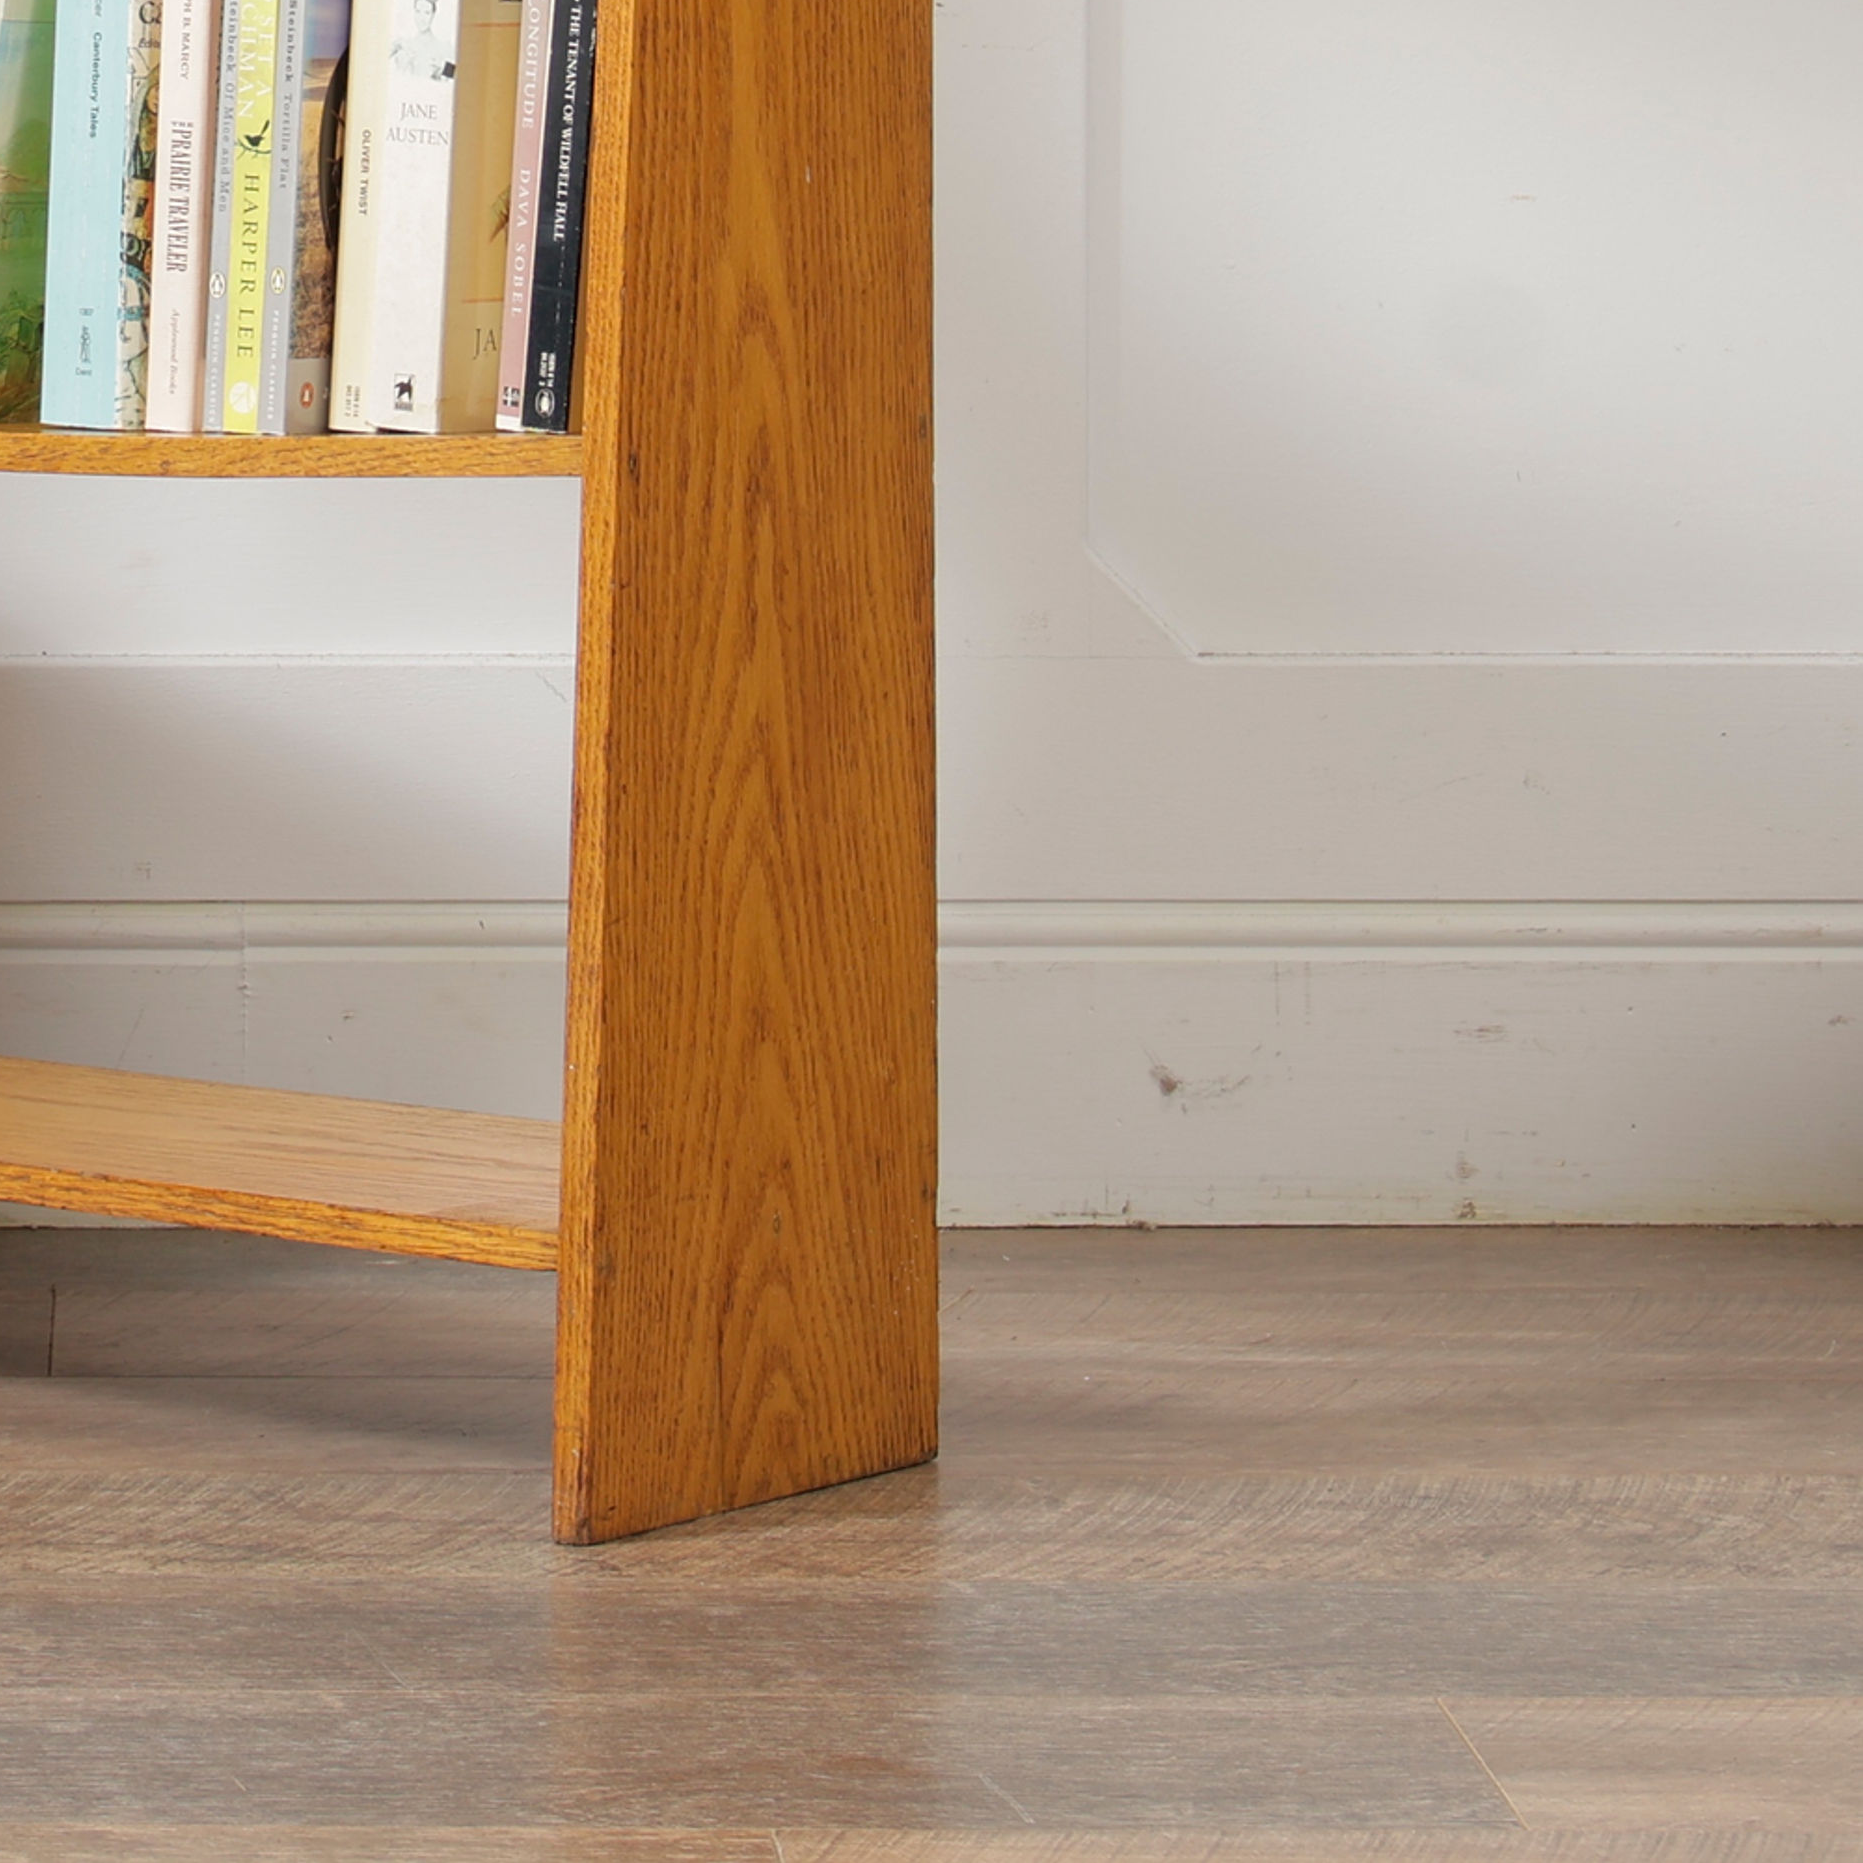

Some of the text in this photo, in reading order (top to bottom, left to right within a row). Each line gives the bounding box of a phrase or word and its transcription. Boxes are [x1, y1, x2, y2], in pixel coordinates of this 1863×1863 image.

[178, 32, 191, 80] MARCY
[283, 0, 298, 82] Steinbeck
[87, 31, 103, 138] Canterbury Tales
[400, 103, 437, 121] JANE
[552, 5, 581, 242] THE TENANT OF WILDFELL HALL
[168, 129, 192, 192] PRAIRIE
[278, 93, 293, 189] Tortilla Flat
[357, 128, 372, 215] OLIVER TWIST
[386, 128, 449, 146] AUSTEN
[165, 197, 190, 272] TRAVELER
[236, 173, 260, 358] HARPER LEE
[509, 169, 532, 317] DAVA SOBEL
